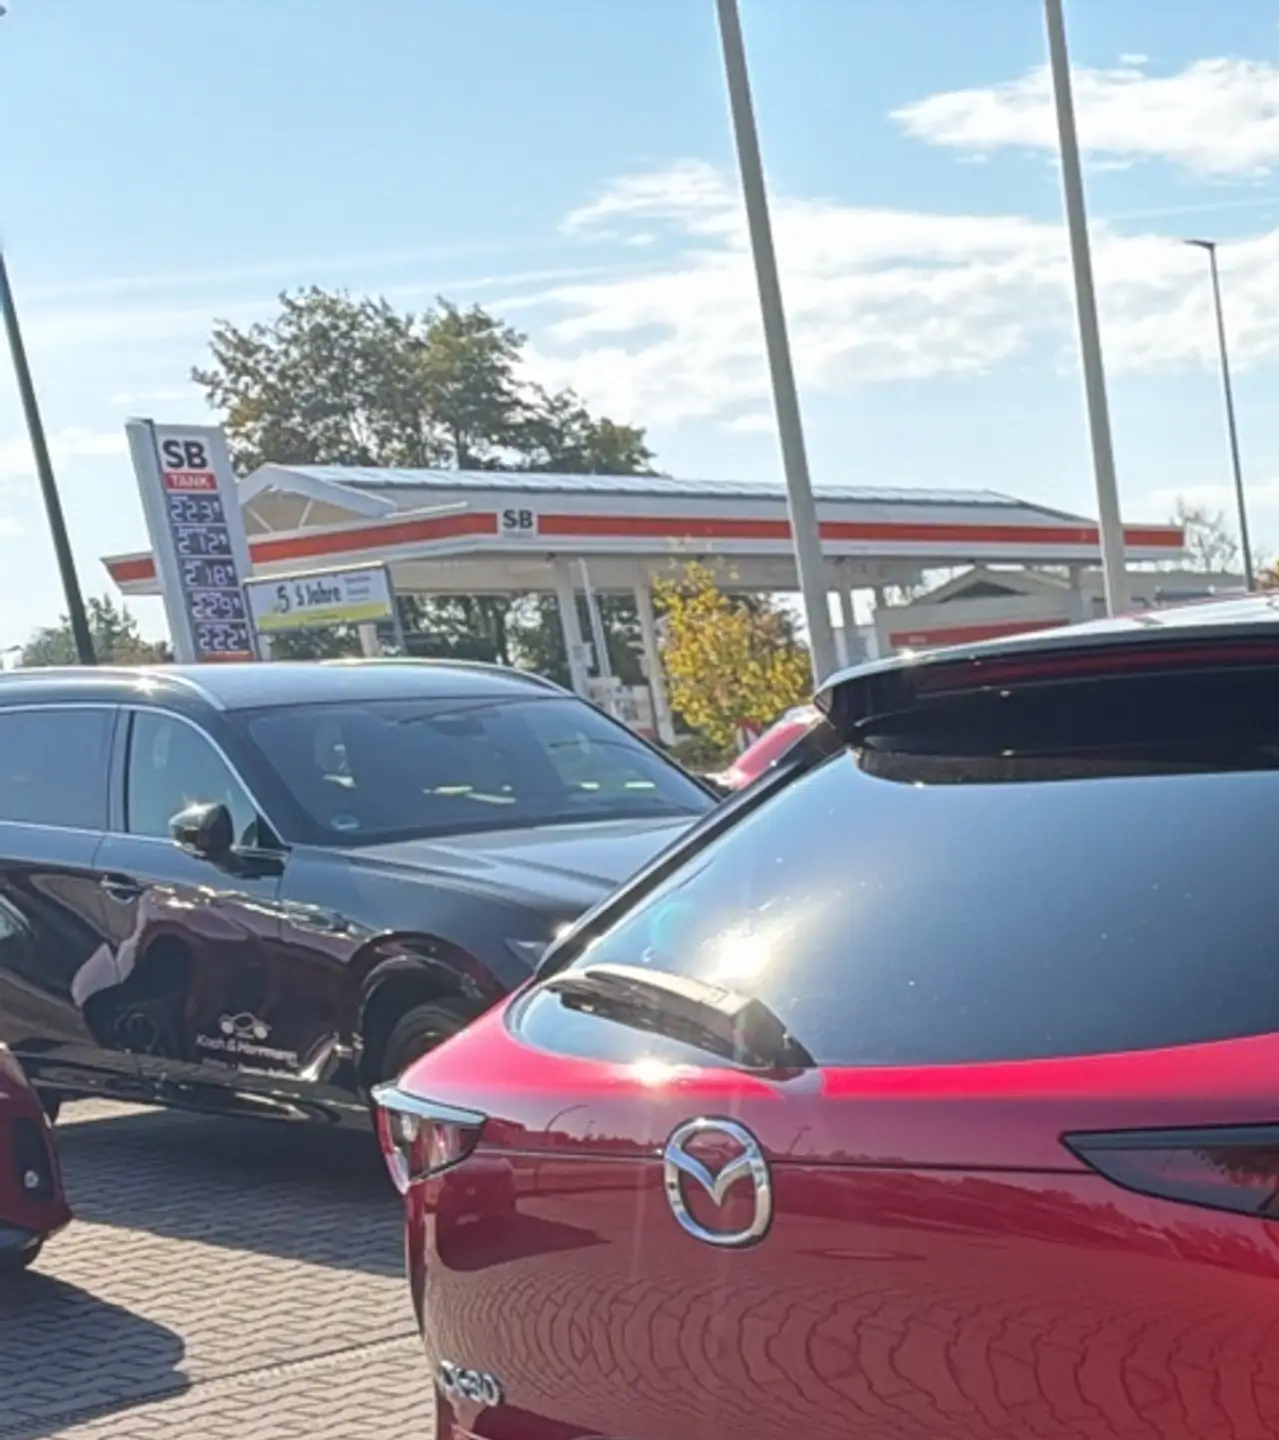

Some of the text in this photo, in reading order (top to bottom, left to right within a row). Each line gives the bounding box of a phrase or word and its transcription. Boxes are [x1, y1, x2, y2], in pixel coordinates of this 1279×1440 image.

[163, 440, 207, 469] SB
[171, 474, 210, 488] TANK
[503, 509, 533, 529] SB
